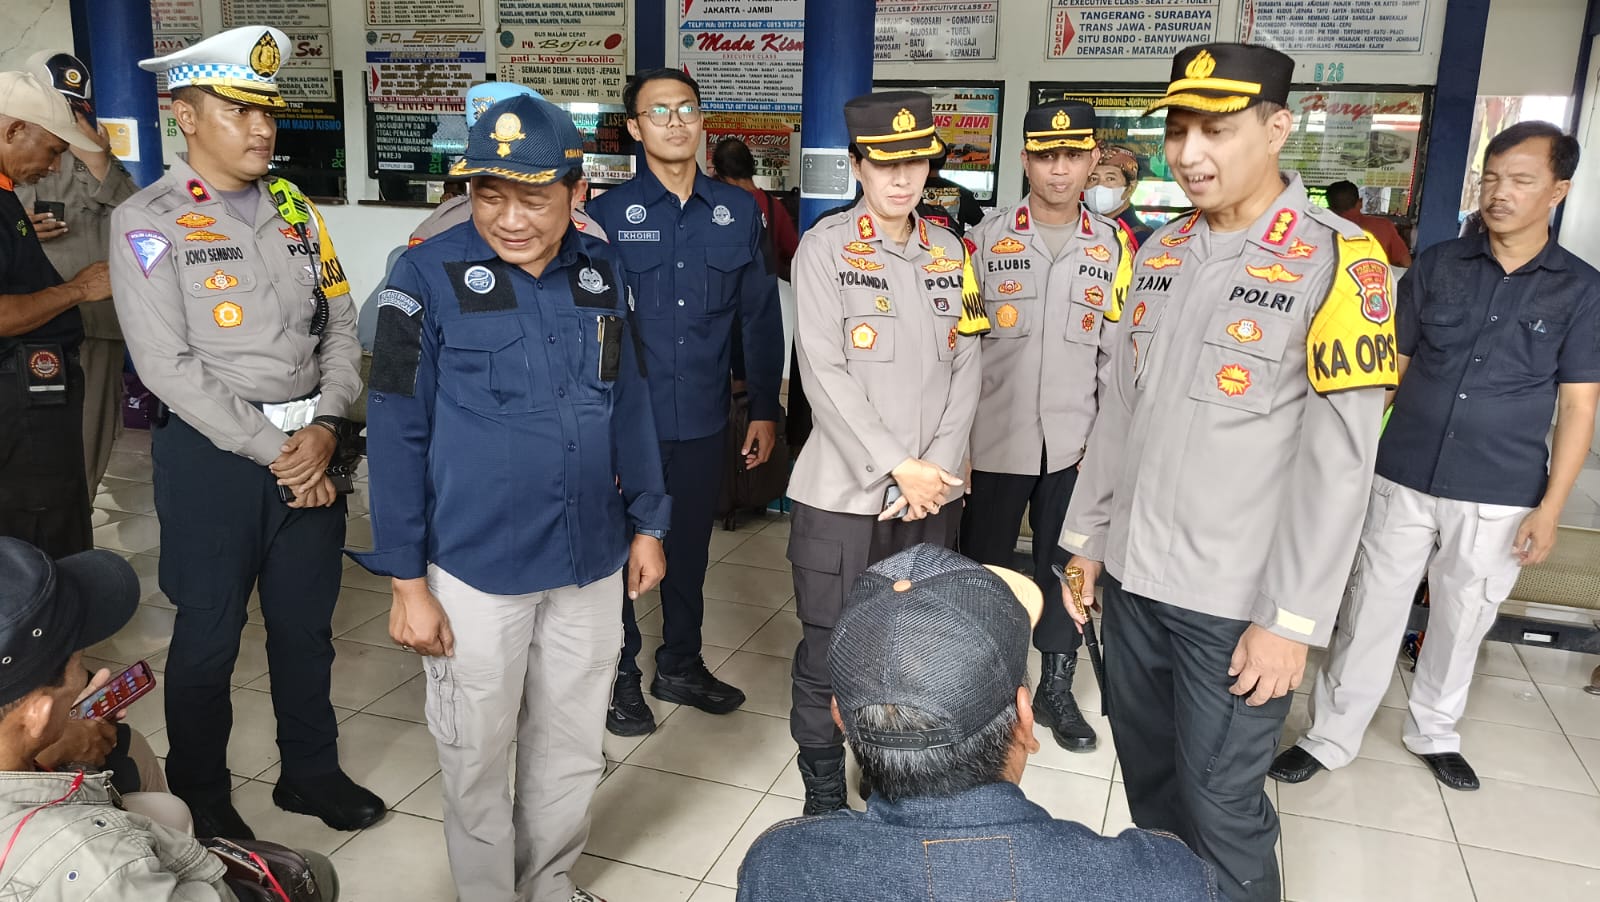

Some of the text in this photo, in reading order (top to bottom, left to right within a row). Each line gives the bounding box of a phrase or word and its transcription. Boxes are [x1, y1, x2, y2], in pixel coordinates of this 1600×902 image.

[952, 16, 980, 24] GONDANG
[1080, 11, 1211, 20] TANGERANG SURABAYA
[1155, 22, 1211, 31] PASURUAN
[403, 31, 483, 43] SEMERU
[697, 32, 804, 52] Madu Kism
[1078, 34, 1210, 43] SITU BONDO BANYUWANGI
[154, 40, 184, 48] JAYA
[1077, 46, 1176, 55] DENPASAR MATARAM
[511, 55, 529, 63] pati
[538, 55, 568, 64] kayen
[522, 66, 551, 74] SEMARANG
[1314, 63, 1344, 81] B 26
[440, 103, 465, 112] TIMU
[955, 116, 990, 128] JAVA
[185, 247, 243, 266] JOKO SEMBODO
[987, 259, 1031, 272] E.LUBIS
[1079, 265, 1112, 282] POLRI
[838, 271, 889, 291] YOLANDA
[1136, 276, 1172, 291] ZAIN
[1229, 286, 1296, 313] POLRI
[1313, 334, 1395, 381] KA OPS
